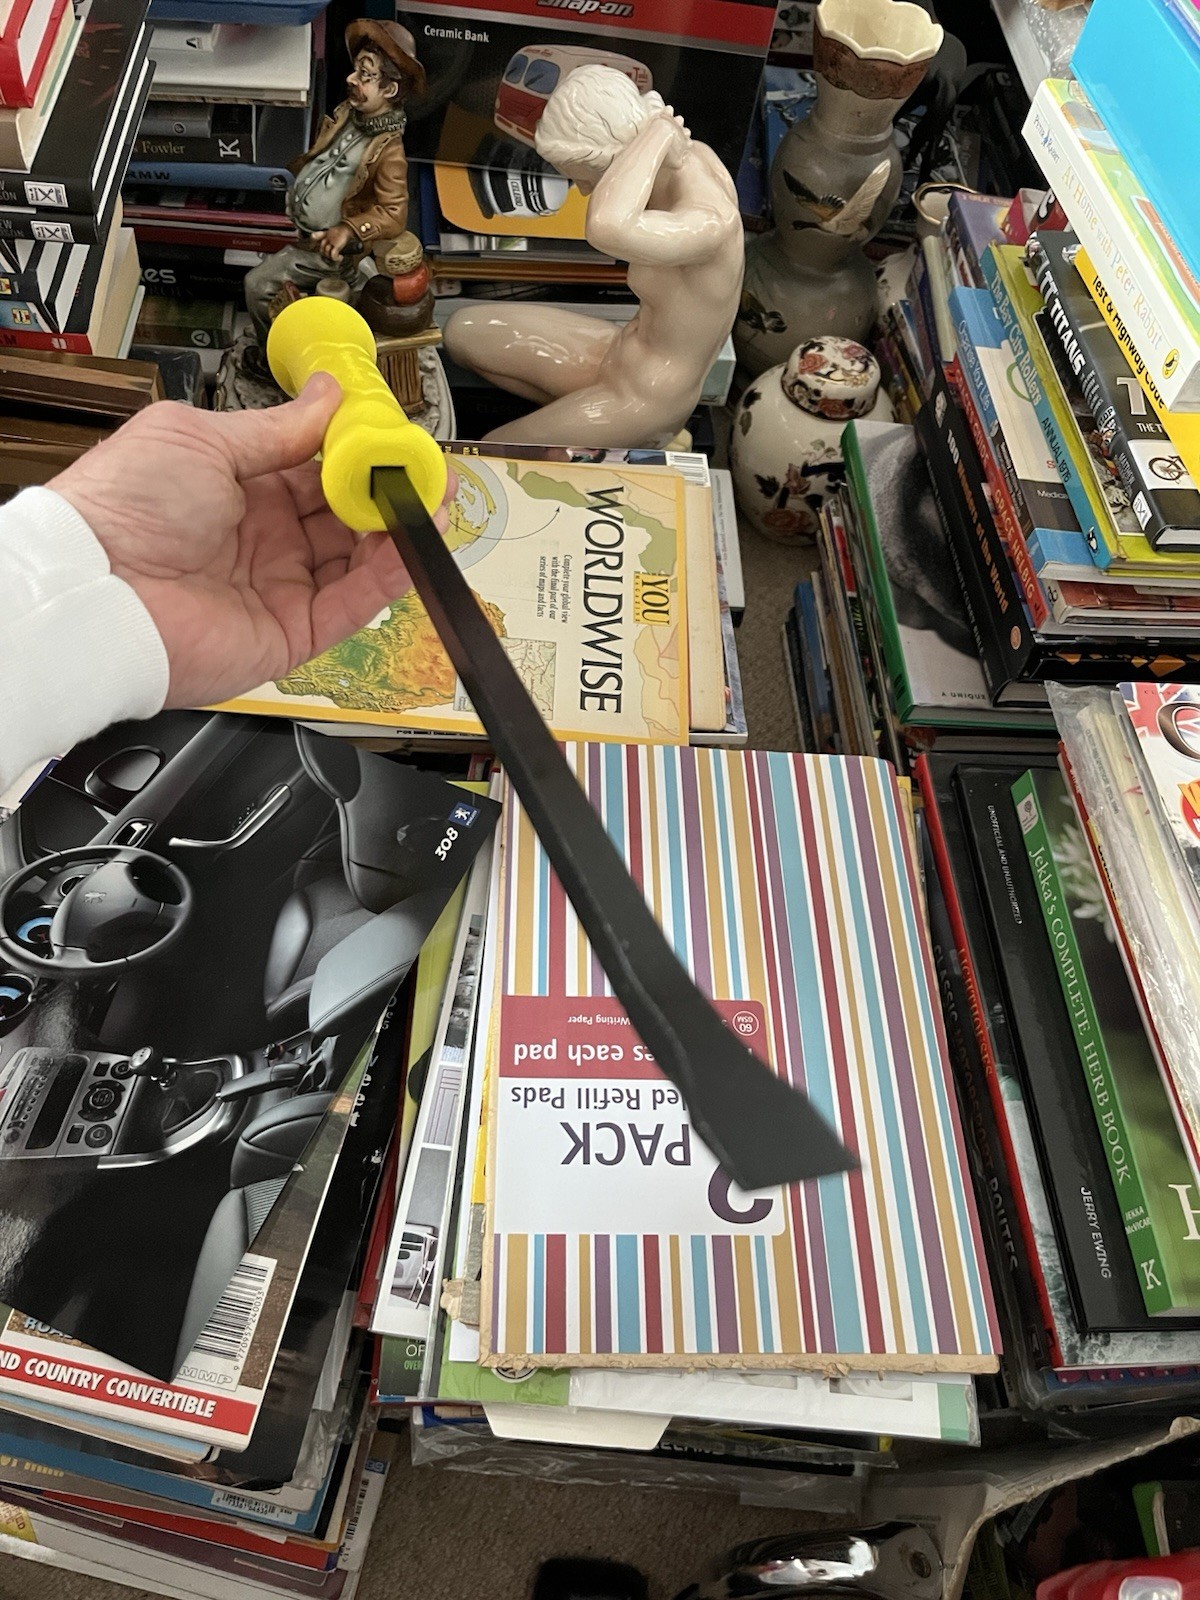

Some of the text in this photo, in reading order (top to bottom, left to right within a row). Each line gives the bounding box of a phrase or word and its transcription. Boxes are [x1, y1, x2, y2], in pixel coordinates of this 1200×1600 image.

[424, 25, 490, 43] Ceramic Bank
[141, 141, 185, 155] Fowler
[218, 139, 241, 158] K
[1062, 165, 1163, 351] At Home with Peter Rabbit
[1050, 298, 1087, 376] TITANS
[1000, 299, 1014, 330] Bay
[1008, 324, 1025, 360] City
[1018, 356, 1042, 405] Rollers
[1041, 417, 1062, 465] ANNUAL
[1136, 422, 1156, 432] THE
[947, 428, 959, 465] 100
[981, 536, 992, 567] the
[989, 562, 1009, 615] World
[994, 488, 1015, 542] GRACE
[1012, 539, 1035, 599] HELBIG
[539, 555, 548, 571] series
[551, 556, 560, 568] with
[551, 568, 560, 577] the
[536, 578, 546, 593] maps
[550, 577, 560, 591] final
[560, 554, 572, 624] Complete your global view
[537, 592, 547, 604] and
[548, 591, 558, 603] part
[580, 486, 624, 714] WORLDWISE
[642, 578, 670, 625] YOU
[536, 604, 547, 618] facts
[951, 692, 986, 700] UNIQUE
[434, 827, 459, 861] 308
[987, 805, 1002, 850] UNOFFICIAL
[998, 848, 1008, 867] AND
[567, 1013, 631, 1026] Writing Paper
[1028, 846, 1058, 917] Jekka's
[1051, 917, 1091, 1036] COMPLETE
[1083, 1040, 1111, 1108] HERB
[1101, 1110, 1131, 1187] BOOK
[513, 1038, 557, 1066] pad
[568, 1043, 624, 1066] each
[511, 1086, 565, 1109] Pads
[577, 1087, 640, 1110] Refill
[560, 1122, 692, 1166] PACK
[1124, 1205, 1145, 1220] JEKKA
[1080, 1186, 1112, 1280] JERRY EWING
[1140, 1258, 1162, 1290] K
[24, 1357, 105, 1391] COUNTRY
[106, 1377, 218, 1419] CONVERTIBLE
